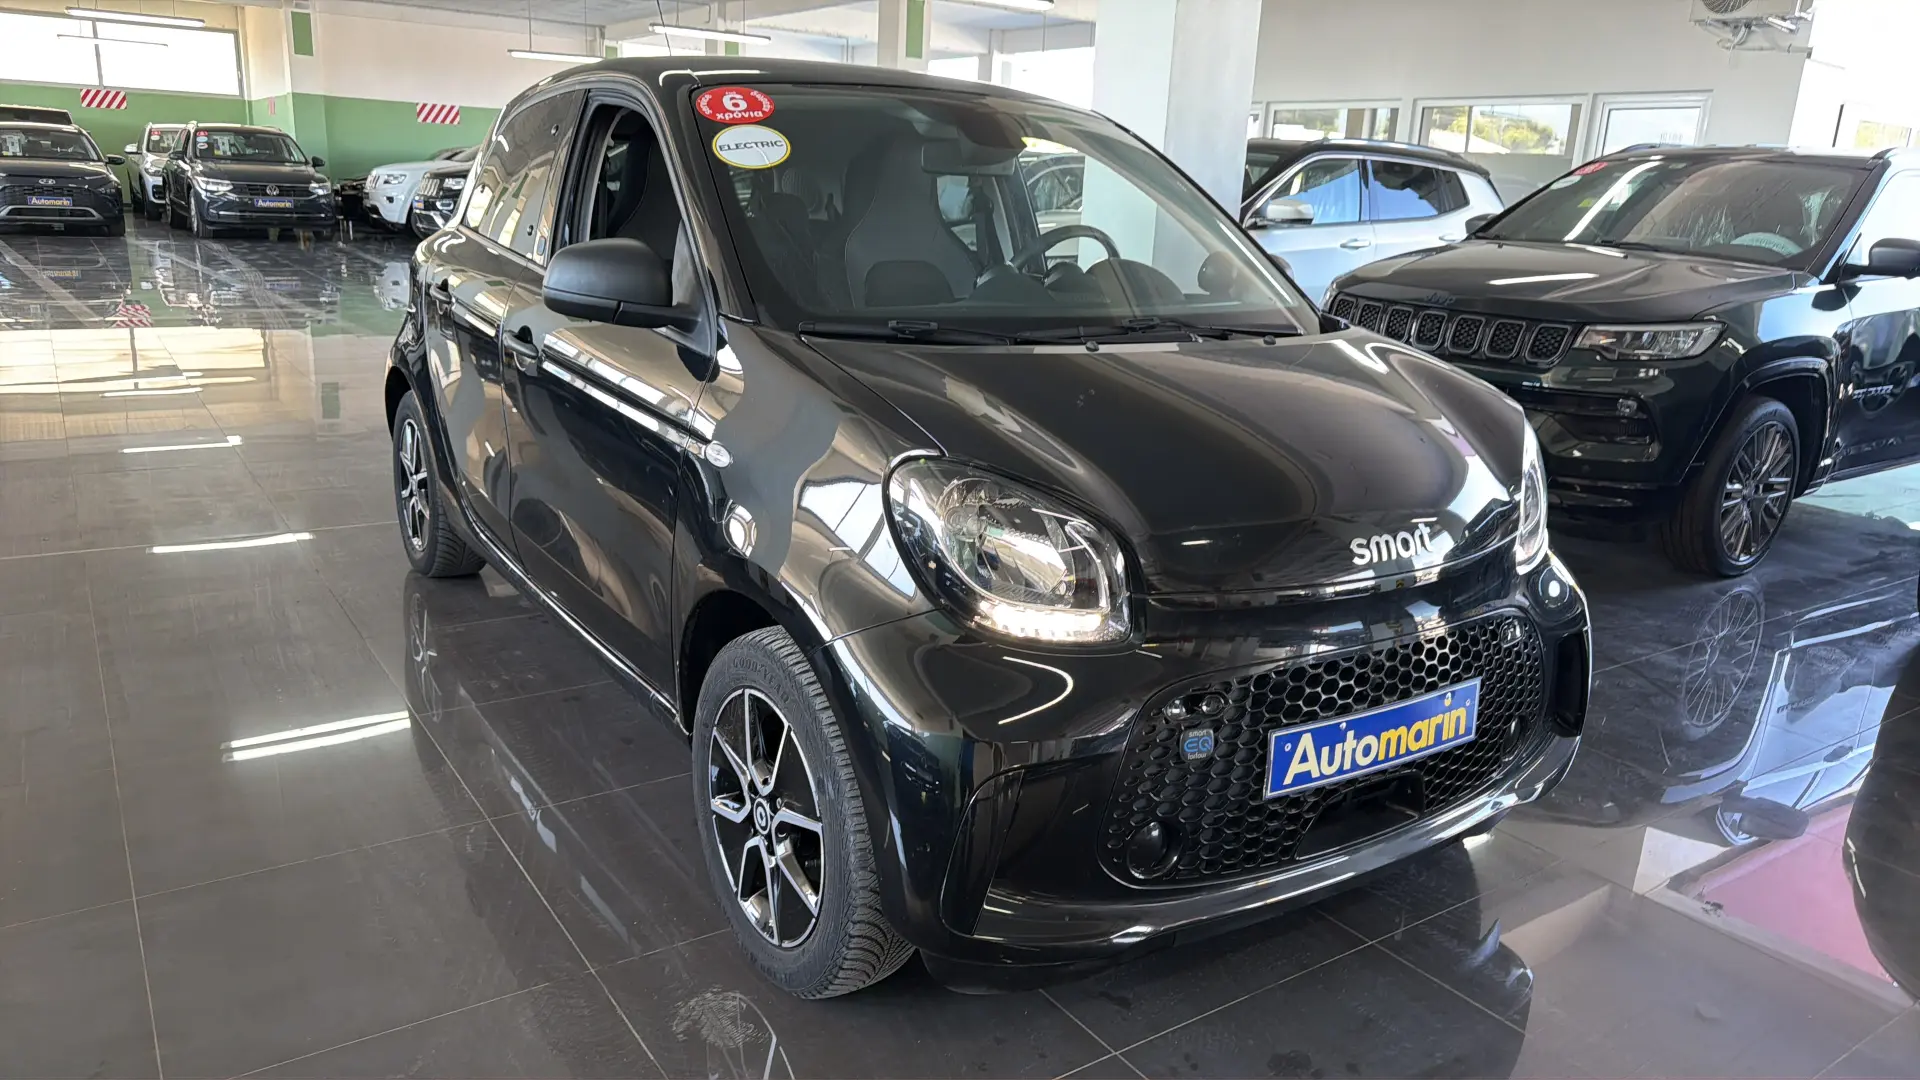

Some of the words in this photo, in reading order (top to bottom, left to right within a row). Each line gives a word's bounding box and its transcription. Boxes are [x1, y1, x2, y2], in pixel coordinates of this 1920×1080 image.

[722, 94, 747, 111] 6
[716, 110, 763, 120] χρόνια
[718, 140, 784, 152] ELECTRIC
[30, 196, 71, 206] Automarin
[257, 199, 292, 208] Automarin
[1349, 522, 1435, 566] smart
[1183, 736, 1212, 753] EQ
[1282, 693, 1467, 786] Automarin
